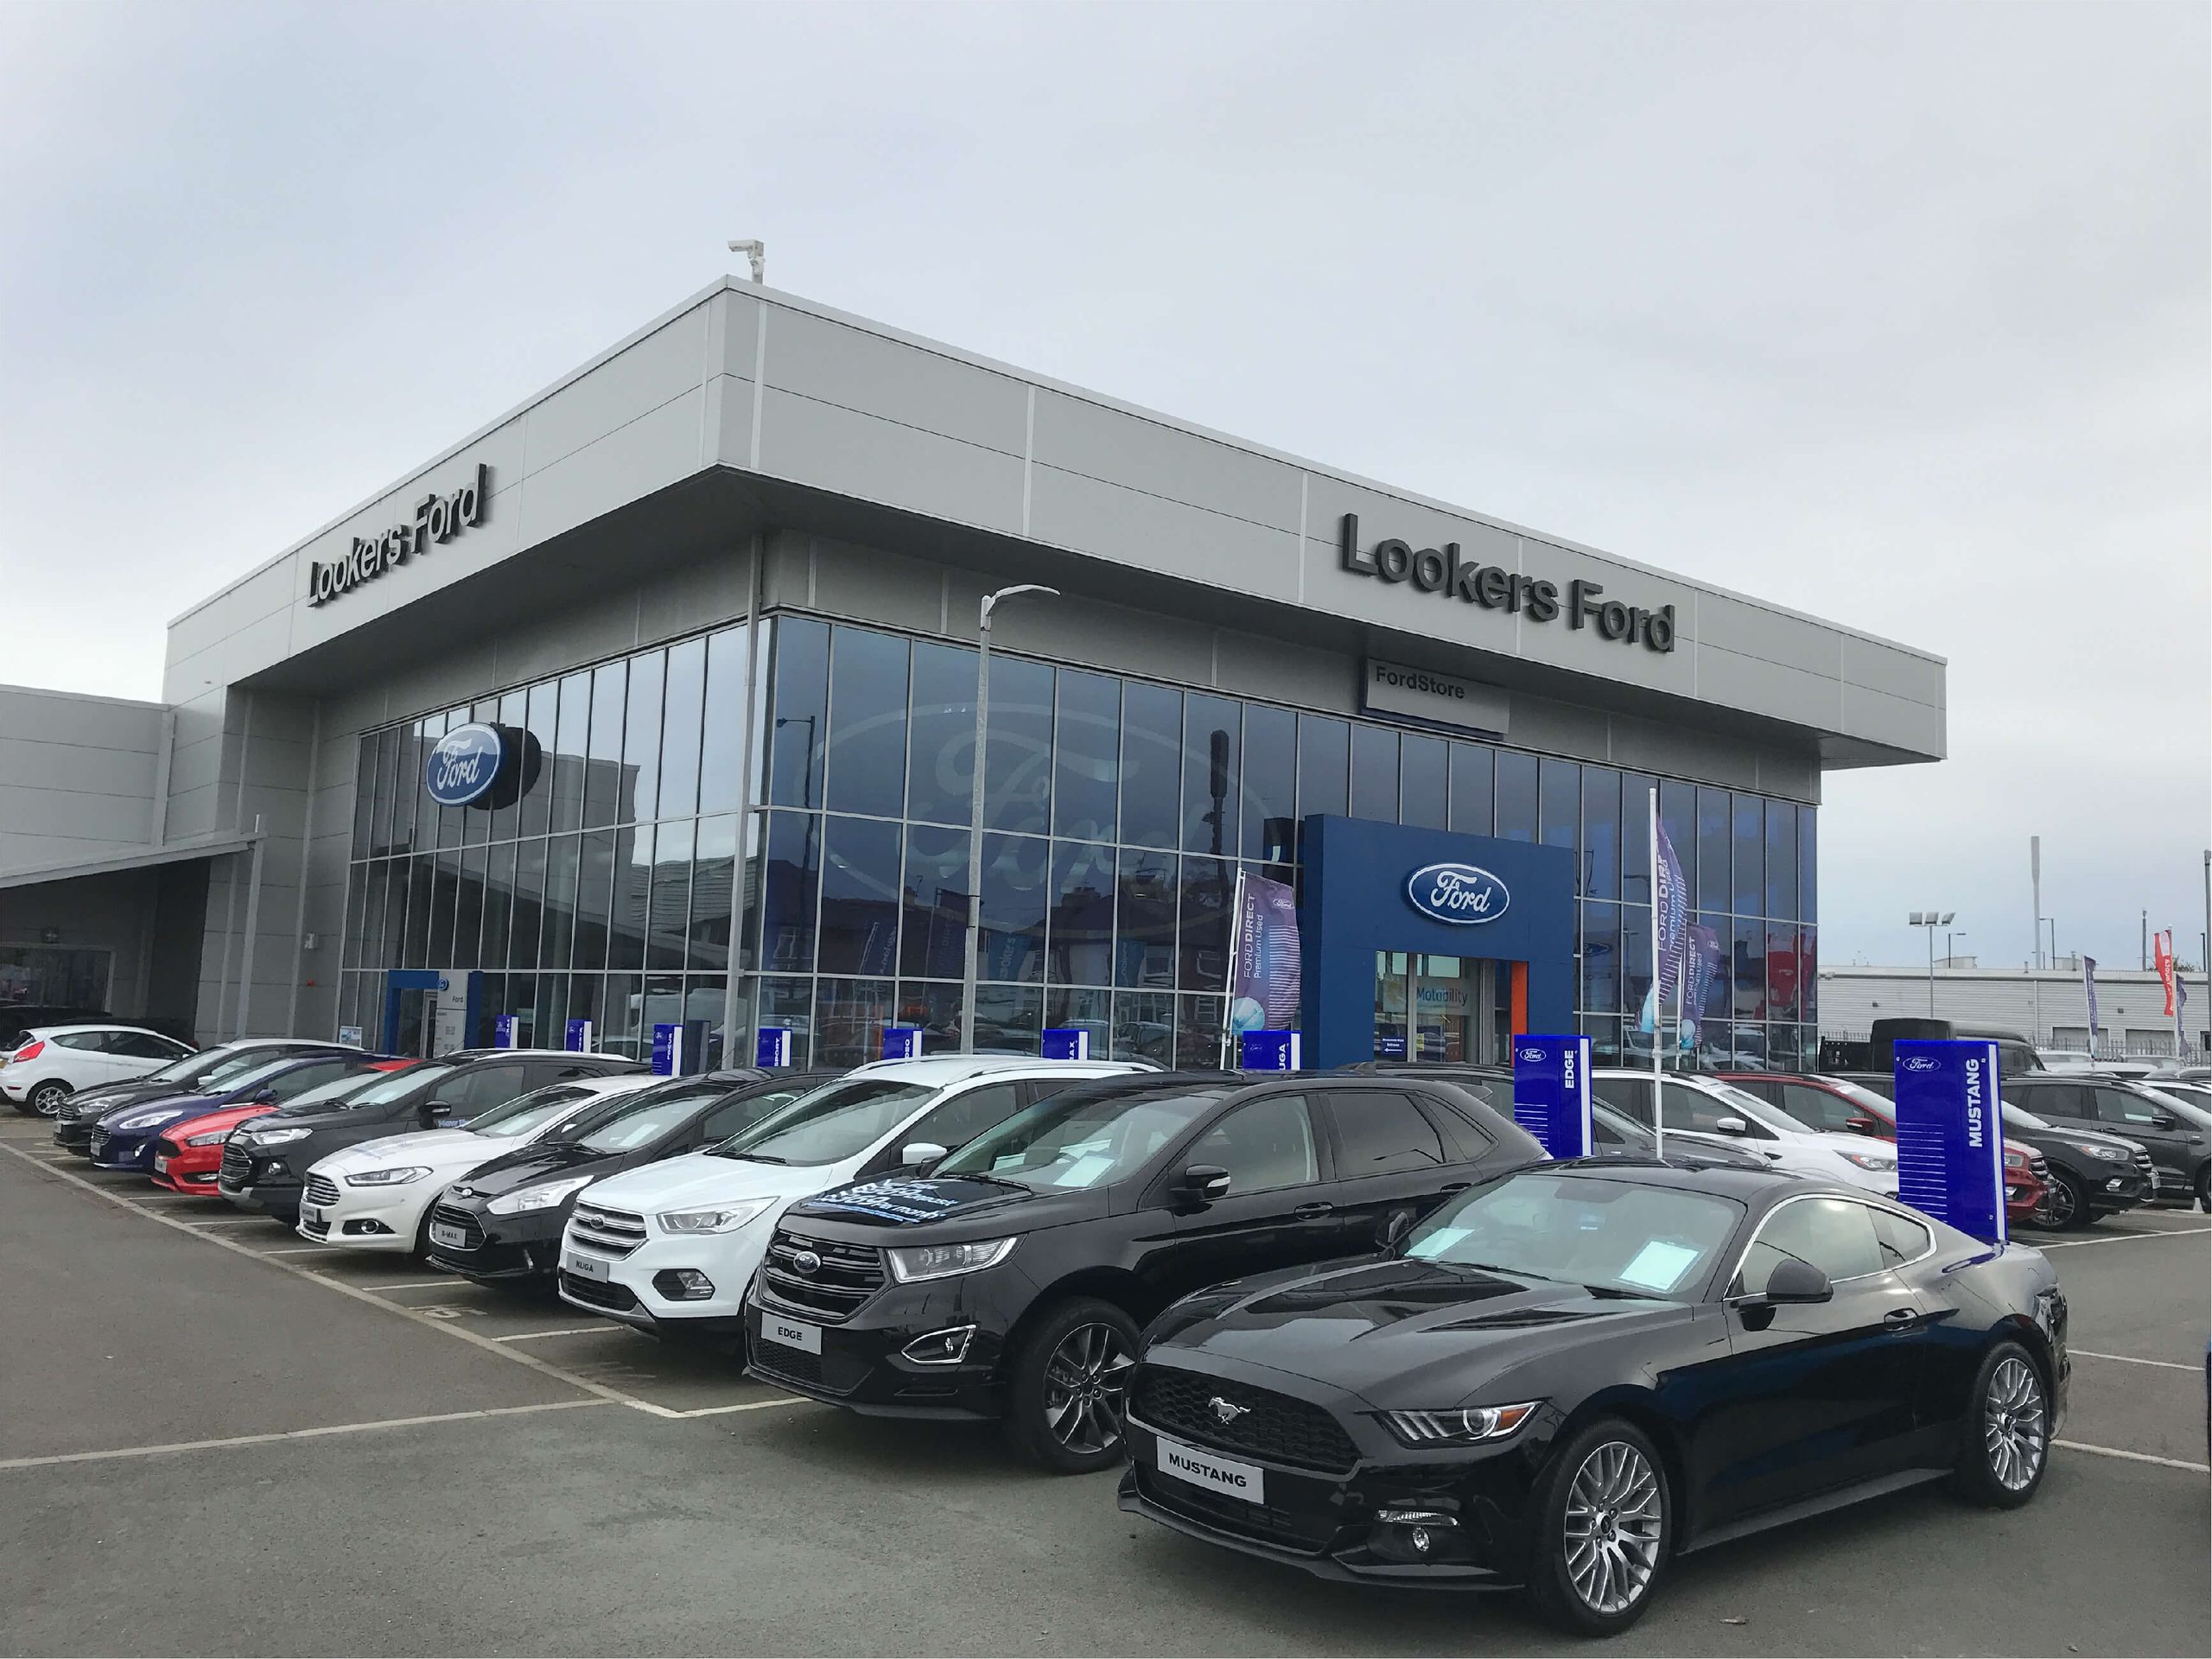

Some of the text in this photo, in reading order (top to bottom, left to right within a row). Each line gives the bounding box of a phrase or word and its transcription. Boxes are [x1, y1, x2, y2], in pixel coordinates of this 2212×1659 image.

[308, 463, 487, 607] Lookers Ford
[1342, 513, 1675, 652] Lookers Ford
[1376, 664, 1465, 700] FordStore
[436, 738, 484, 791] Ford
[1430, 871, 1492, 912] Ford
[1254, 914, 1264, 979] Premium Used
[1416, 986, 1468, 1007] Motability
[1564, 1050, 1575, 1089] EDGE
[1965, 1058, 1983, 1147] MUSTANG
[575, 1260, 594, 1273] KUGA
[778, 1326, 803, 1341] EDGE
[1168, 1452, 1247, 1488] MUSTANG
